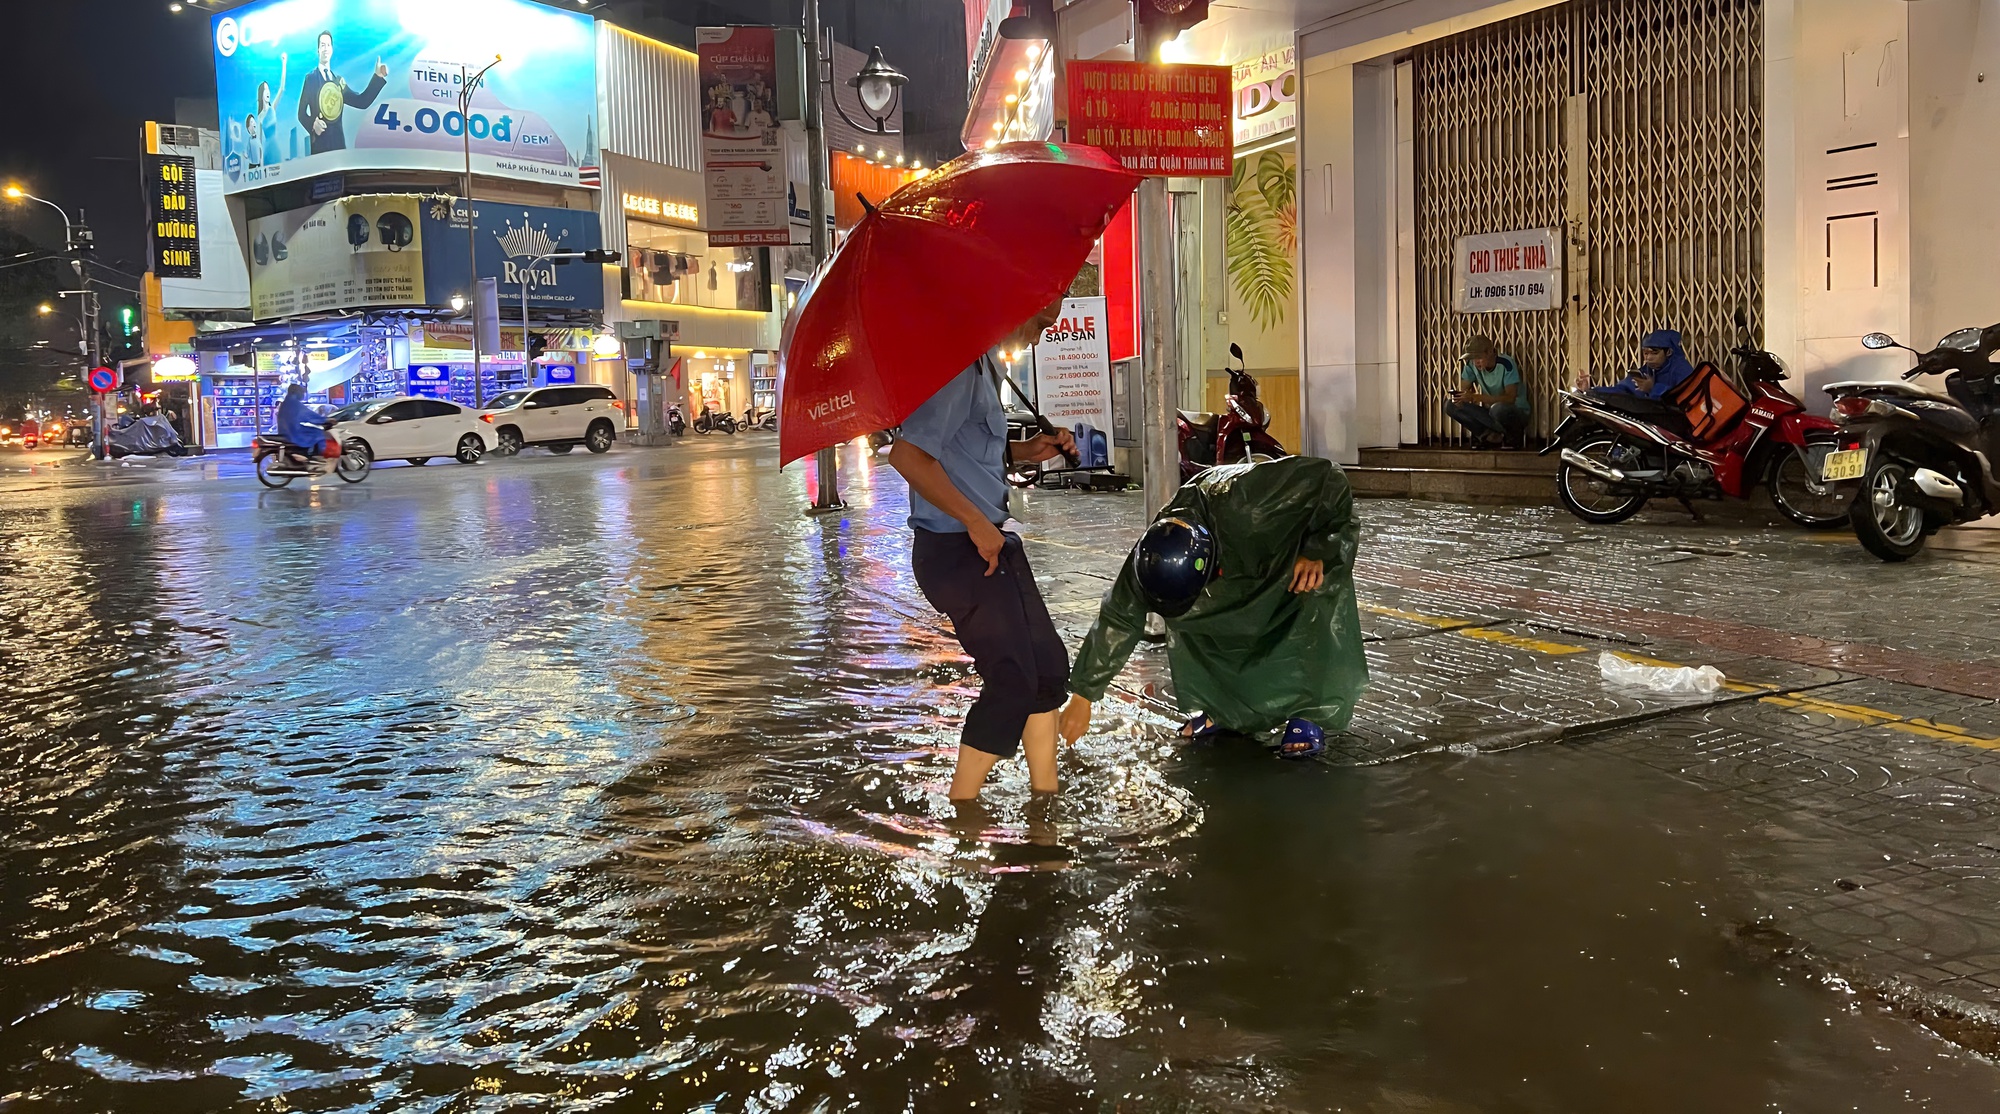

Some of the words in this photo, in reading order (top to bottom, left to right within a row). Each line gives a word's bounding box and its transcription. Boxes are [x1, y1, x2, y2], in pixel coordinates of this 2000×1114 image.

[413, 65, 448, 84] TIỀN
[432, 88, 453, 99] CHI
[374, 103, 513, 143] 4.000đ
[1120, 128, 1132, 147] XE
[1183, 156, 1208, 170] THANH
[162, 163, 184, 184] GỘI
[163, 189, 186, 211] ĐẦU
[157, 218, 196, 239] DƯỠNG
[162, 249, 191, 267] SINH
[1469, 250, 1490, 274] CHO
[1493, 242, 1520, 273] THUÊ
[502, 260, 558, 291] Royal
[1470, 286, 1483, 298] LH:
[1484, 285, 1507, 298] 0906
[1508, 284, 1526, 297] 510
[1527, 283, 1545, 296] 694
[808, 389, 856, 421] viettel
[1751, 407, 1775, 420] YAMAHA
[1826, 464, 1863, 479] 230.91
